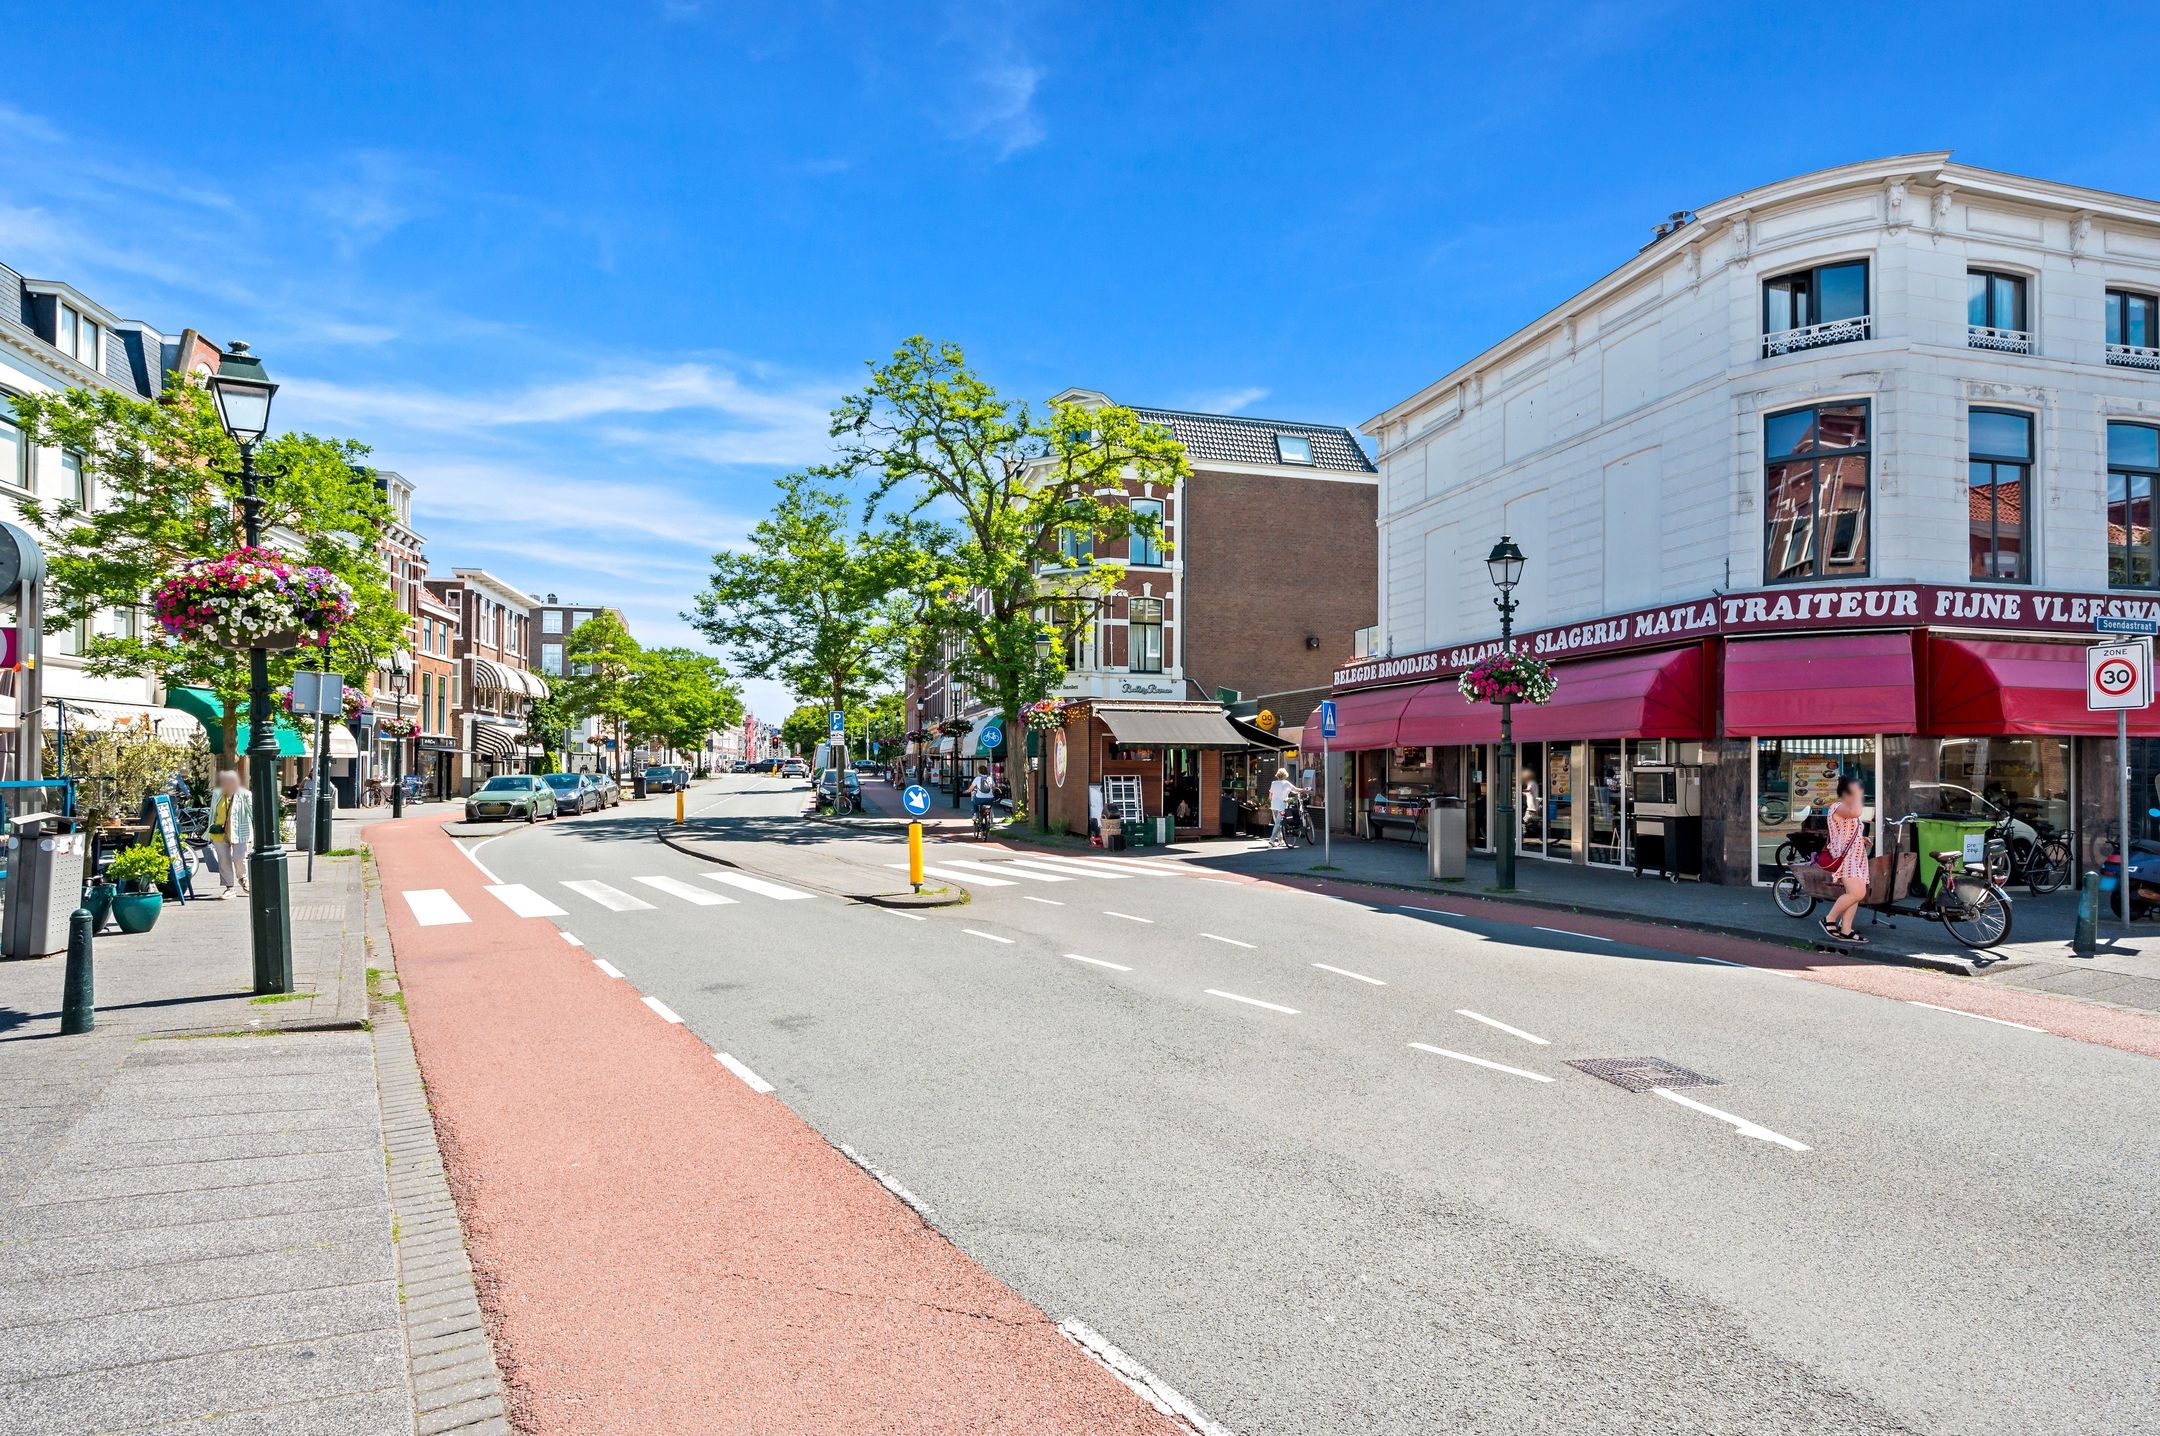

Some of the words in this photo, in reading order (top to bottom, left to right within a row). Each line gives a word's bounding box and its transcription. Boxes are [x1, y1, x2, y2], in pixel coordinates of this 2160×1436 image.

[1721, 590, 1919, 625] TRAITEUR
[1934, 590, 2021, 620] FIJNE
[2103, 619, 2153, 631] Soendastraat
[1333, 664, 1377, 686] BELEGDE
[1378, 653, 1438, 678] BROODJES
[1534, 618, 1629, 654] SLAGERIJ
[1634, 602, 1718, 638] MATLA
[2103, 648, 2128, 657] ZONE
[2103, 669, 2130, 685] 30
[833, 713, 842, 723] P
